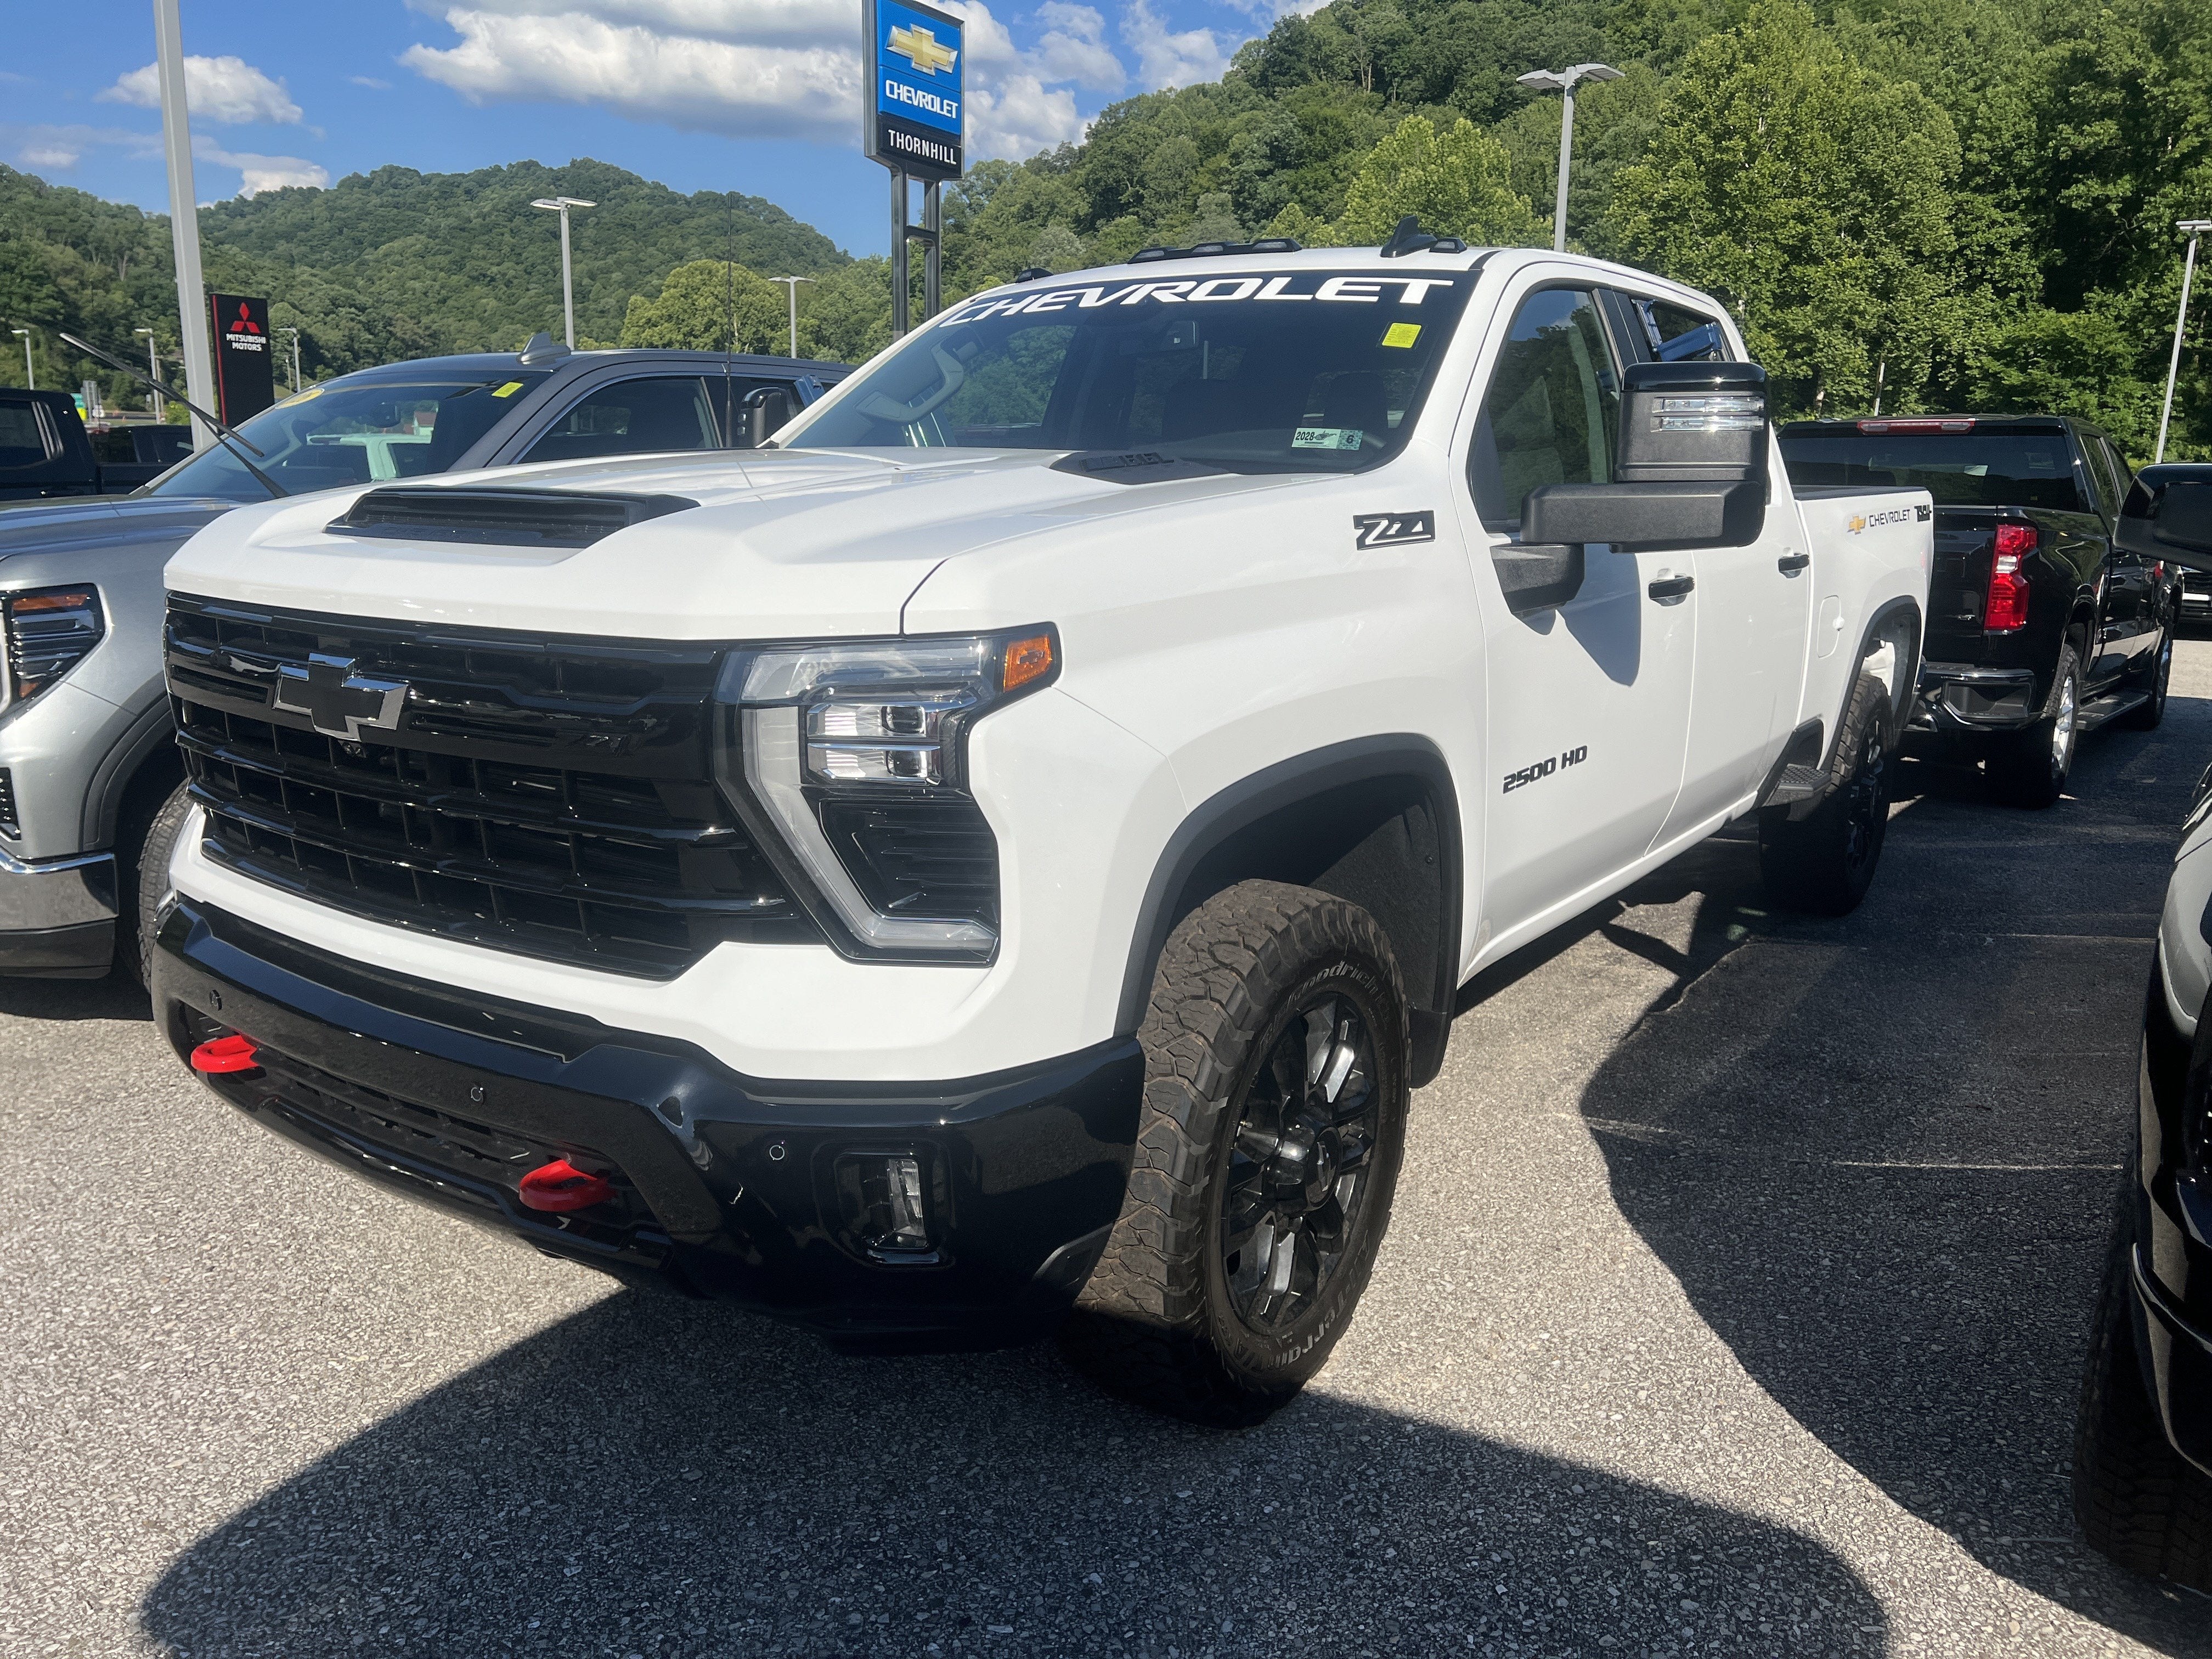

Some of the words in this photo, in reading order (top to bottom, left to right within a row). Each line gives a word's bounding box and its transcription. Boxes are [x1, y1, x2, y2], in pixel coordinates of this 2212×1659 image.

[885, 80, 958, 119] CHEVROLET
[888, 129, 957, 165] THORNHILL
[939, 276, 1454, 328] CHEVROLET
[226, 334, 266, 344] MITSUBISHI
[232, 342, 262, 351] MOTORS
[1295, 431, 1315, 441] 2028
[1346, 435, 1355, 444] 6
[1869, 509, 1910, 527] CHEVROLET
[1503, 756, 1556, 794] 2500
[1561, 745, 1588, 770] HD
